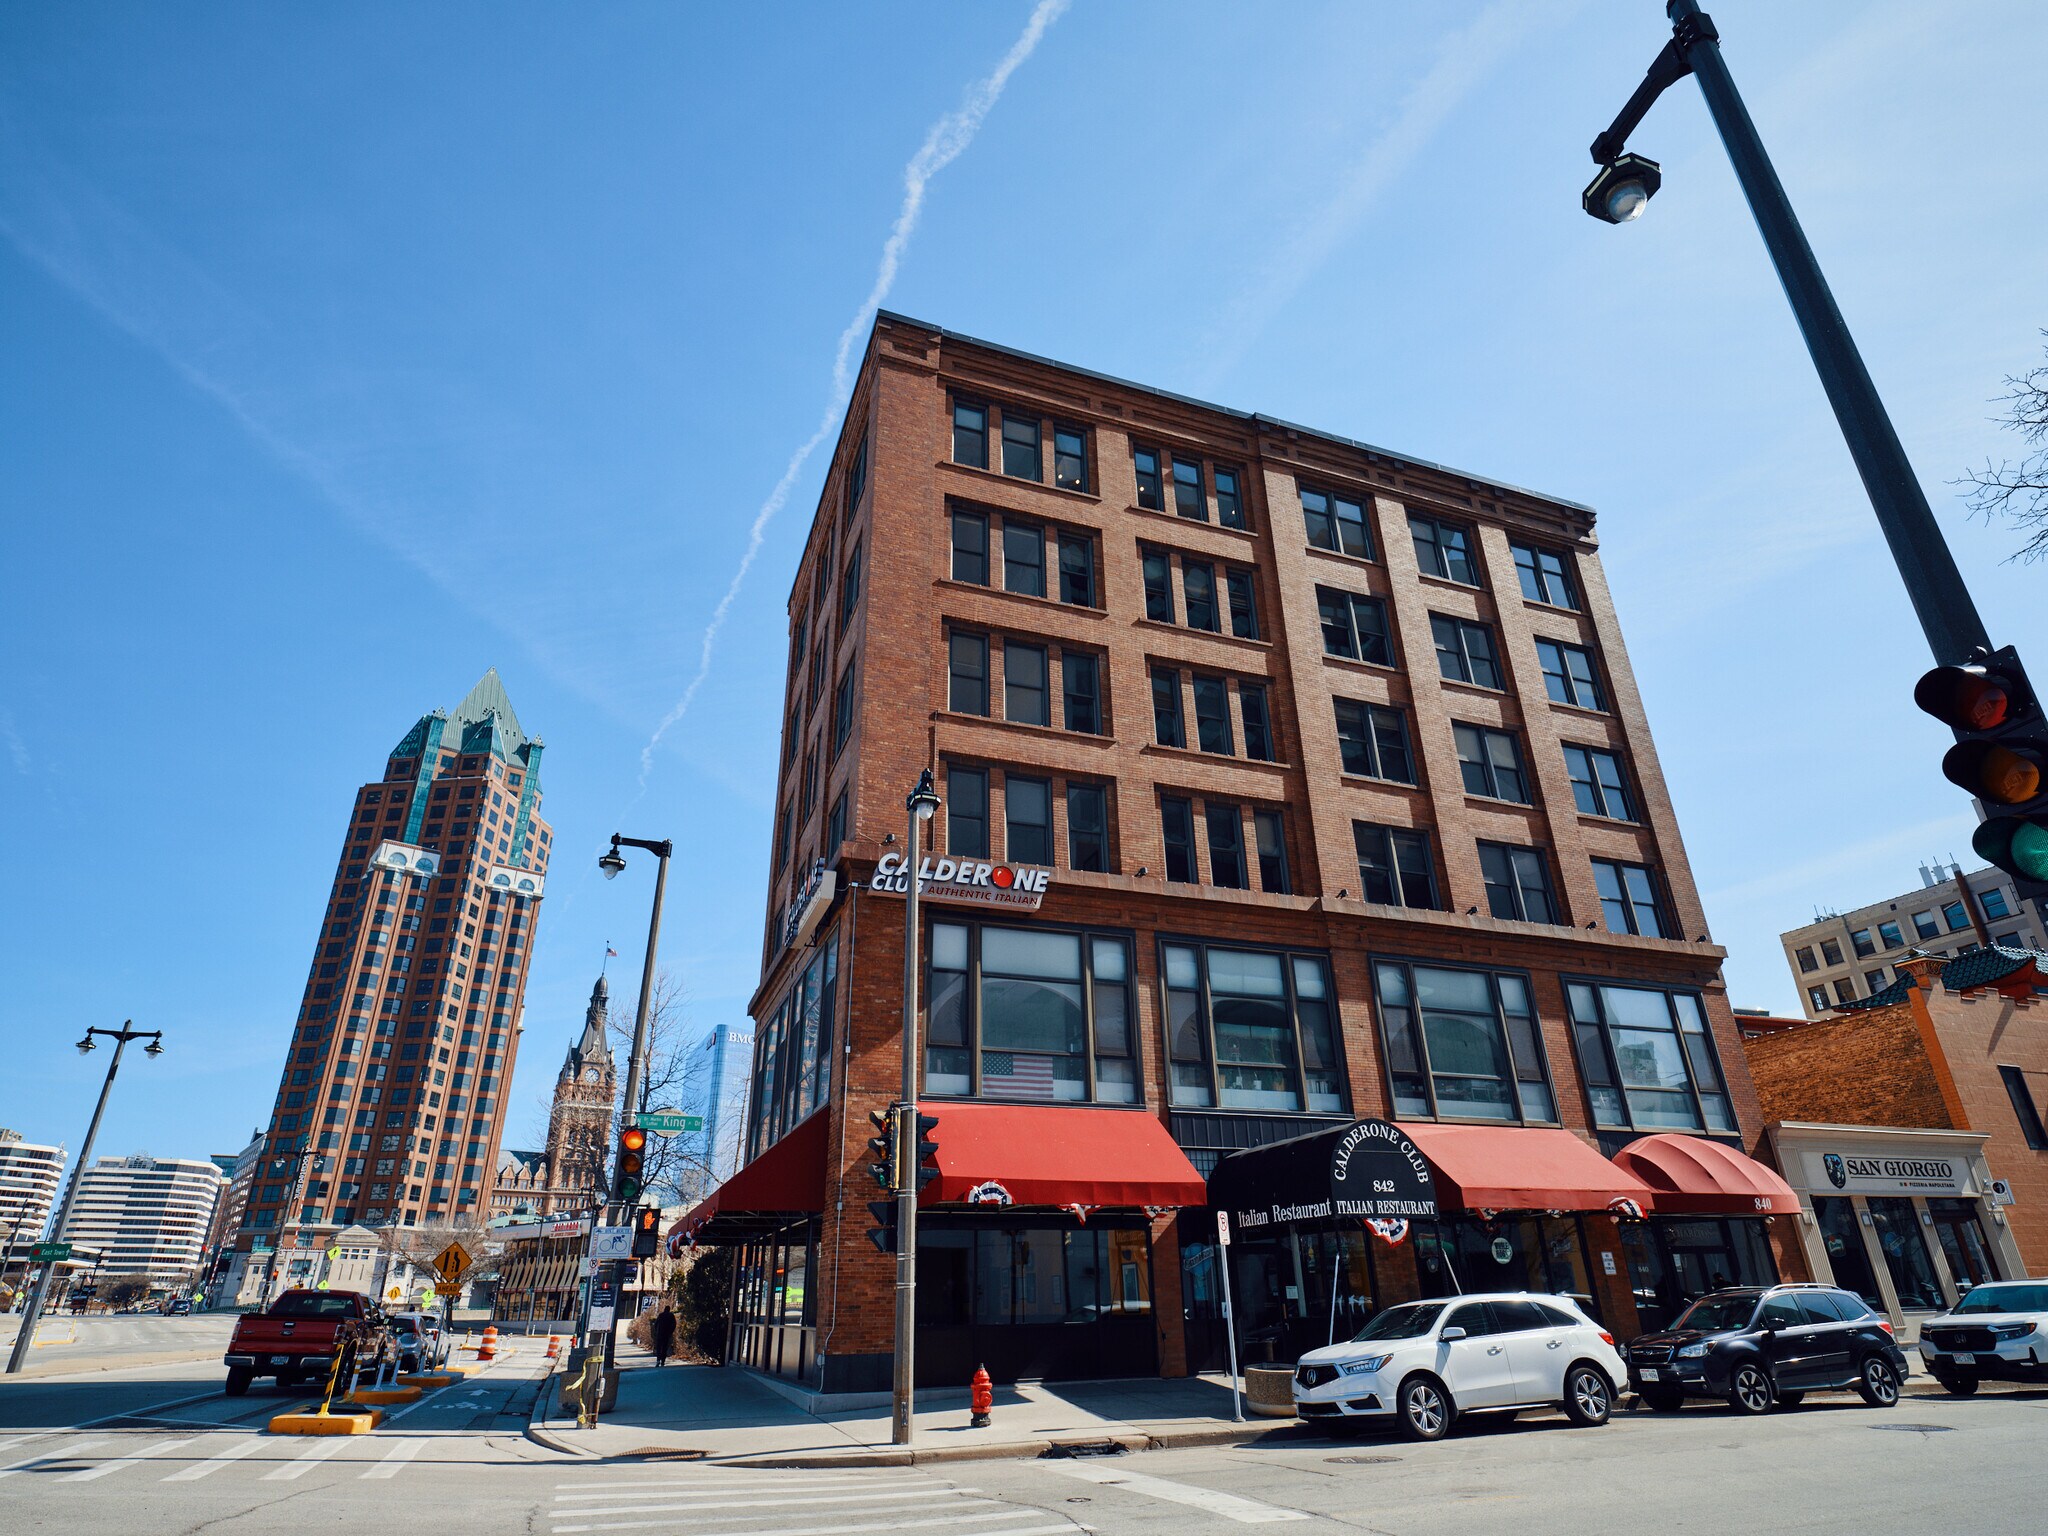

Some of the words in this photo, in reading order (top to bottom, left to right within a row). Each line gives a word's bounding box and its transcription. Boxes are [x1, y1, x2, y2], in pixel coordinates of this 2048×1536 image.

[927, 886, 992, 901] AUTHENTIC
[994, 893, 1039, 906] ITALIAN
[663, 1115, 686, 1130] King
[1334, 1123, 1400, 1181] CALDERONE
[1400, 1141, 1429, 1184] CLUB
[1846, 1160, 1882, 1175] SAN
[1884, 1160, 1953, 1178] GIORGIO
[1373, 1180, 1395, 1192] 842
[1336, 1200, 1374, 1214] ITALIAN
[1376, 1200, 1435, 1215] RESTAURANT
[1754, 1198, 1772, 1210] 840
[1237, 1208, 1269, 1228] Italian
[1271, 1197, 1332, 1223] Restaurant
